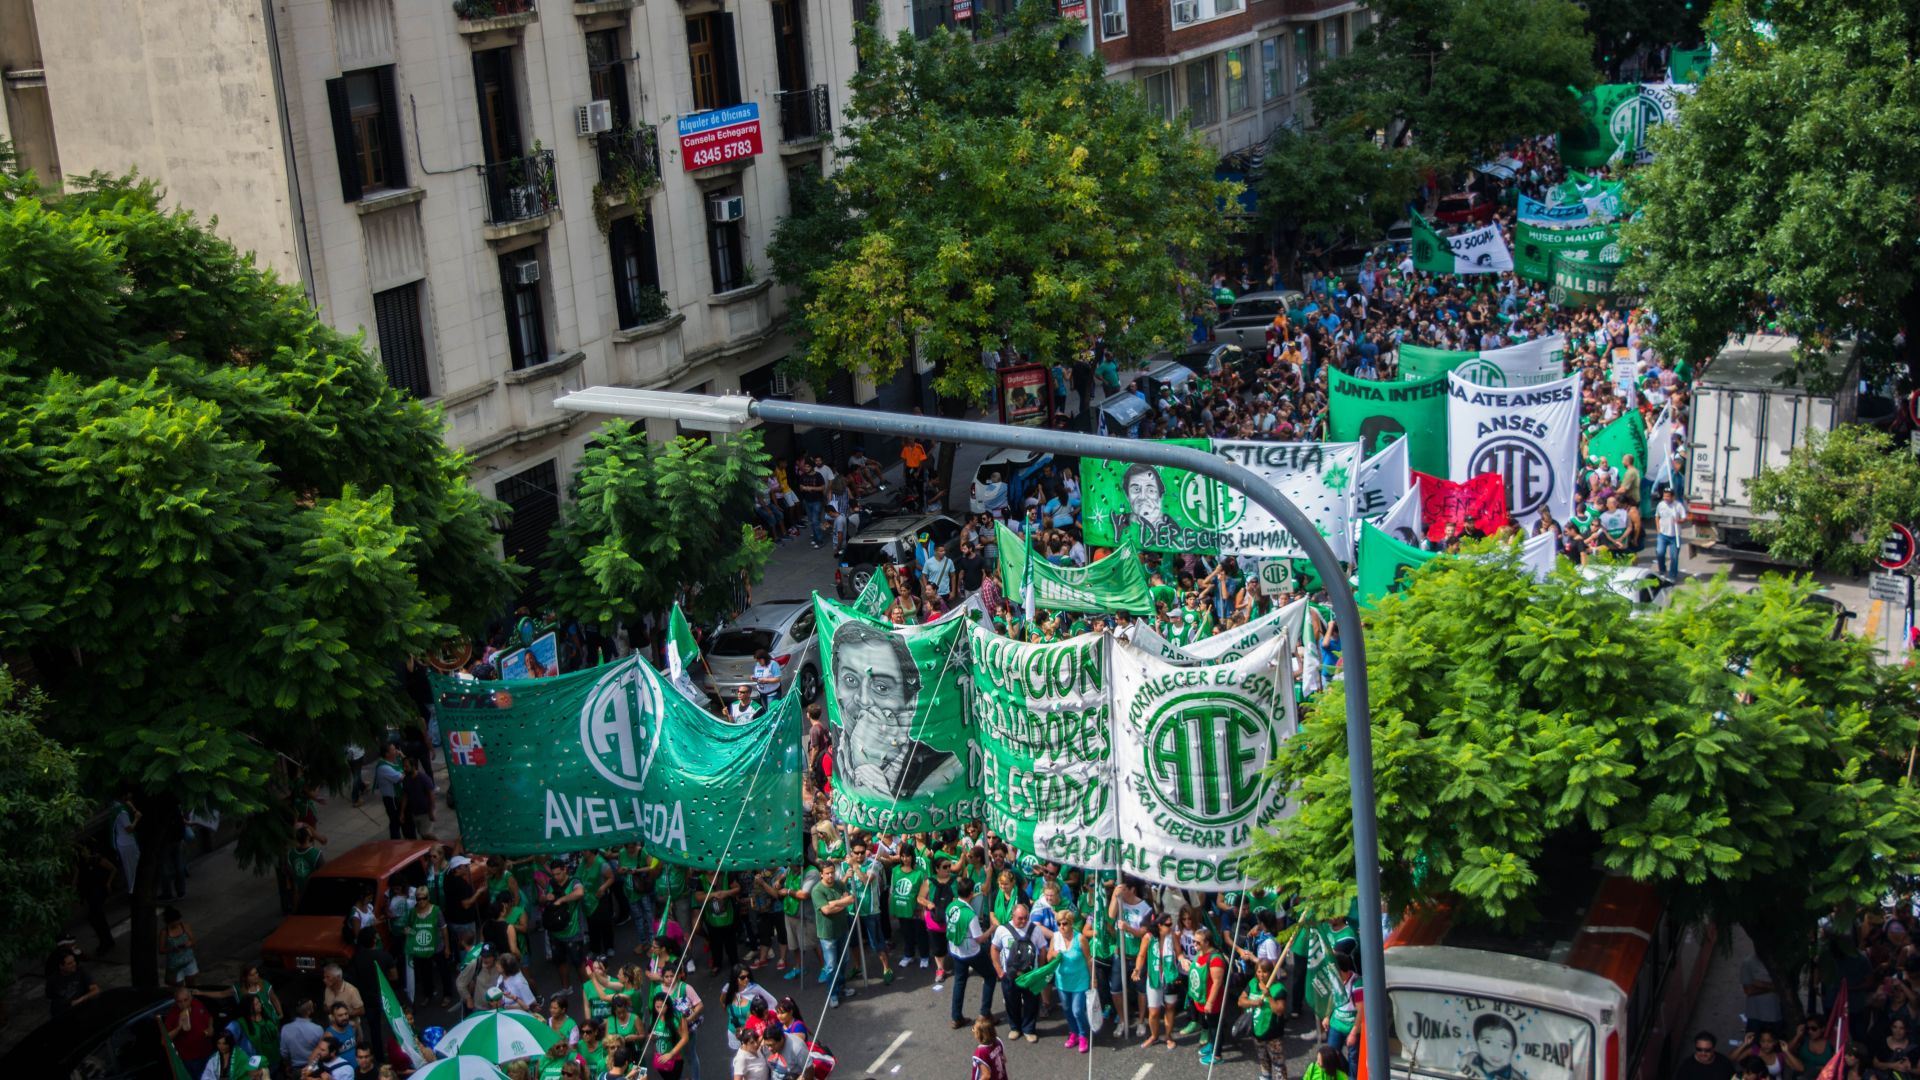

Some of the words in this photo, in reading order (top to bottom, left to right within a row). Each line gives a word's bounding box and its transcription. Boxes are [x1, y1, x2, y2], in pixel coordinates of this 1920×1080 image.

[680, 119, 709, 132] Alquiler
[711, 114, 719, 124] de
[722, 109, 751, 122] Oficinas
[717, 125, 757, 139] Echegaray
[694, 147, 721, 165] 4345
[724, 140, 752, 158] 5783
[1529, 231, 1562, 243] MUSEO
[1334, 380, 1384, 401] JUNTA
[1470, 389, 1508, 407] ATE
[1510, 386, 1573, 406] ANSES
[1477, 415, 1548, 439] ANSES
[1697, 453, 1708, 461] 80
[1129, 670, 1208, 729] FORTALECER
[1215, 669, 1237, 686] EL
[1241, 673, 1286, 721] ESTADO
[1152, 704, 1261, 816] ATE
[1154, 812, 1226, 848] LIBERAR
[1232, 825, 1251, 847] LA
[1049, 832, 1150, 871] CAPITAL
[1466, 998, 1485, 1012] EL
[1407, 1011, 1462, 1040] JONÁS
[1524, 1043, 1541, 1057] DE
